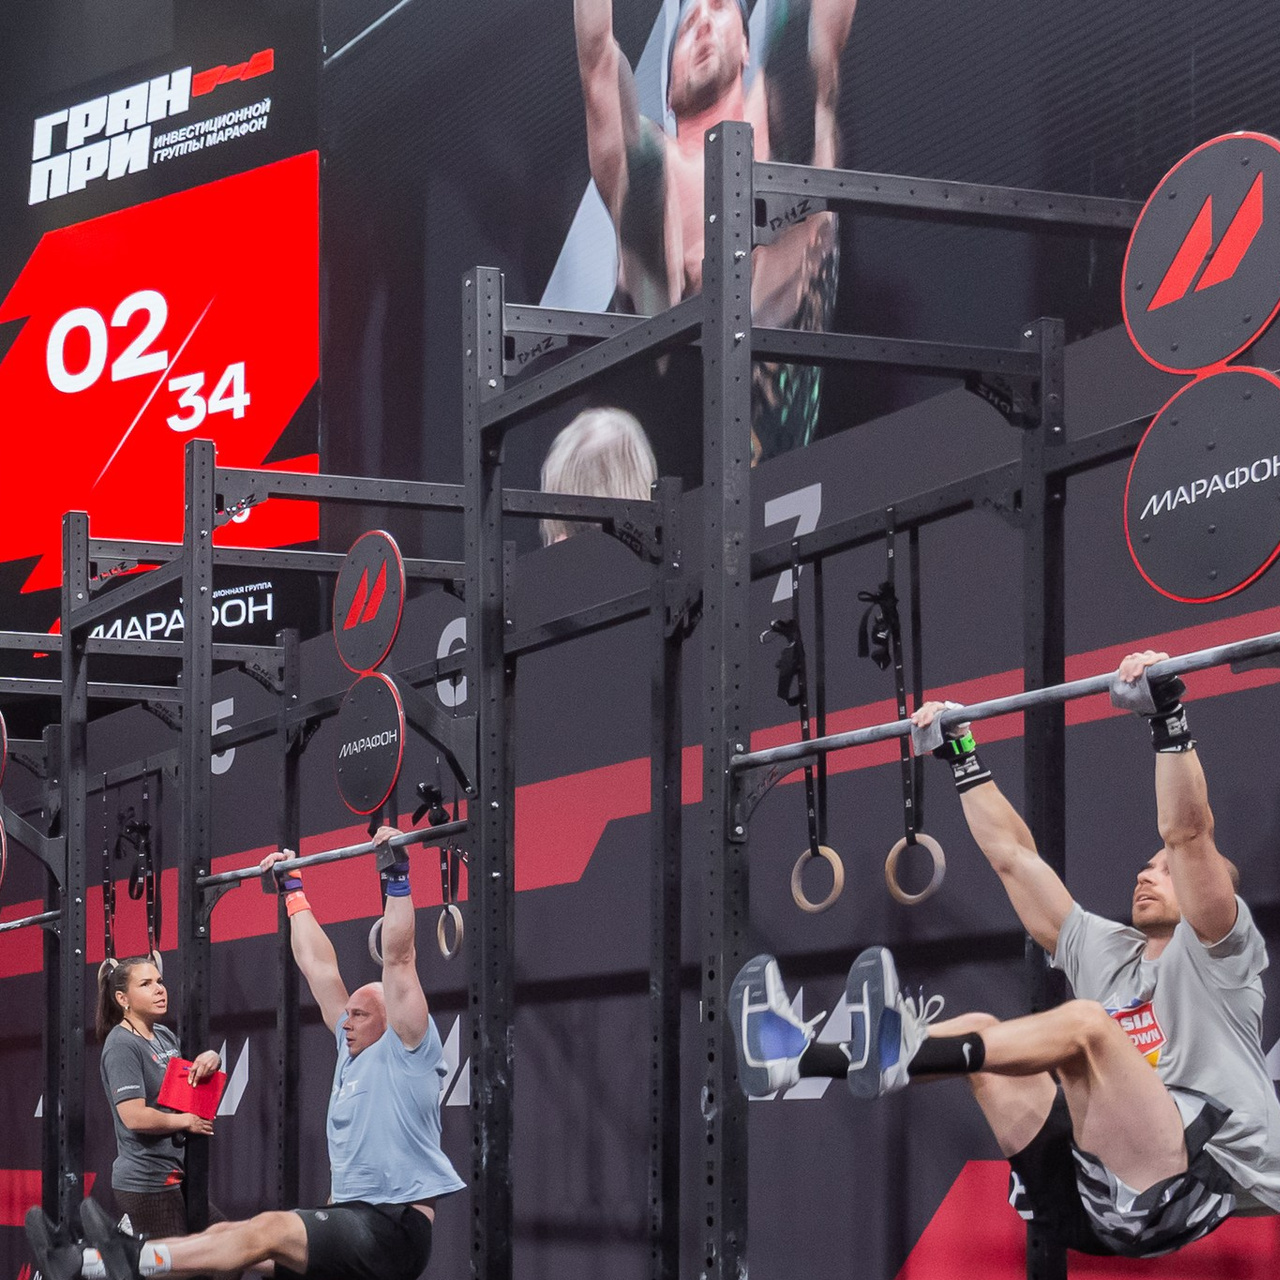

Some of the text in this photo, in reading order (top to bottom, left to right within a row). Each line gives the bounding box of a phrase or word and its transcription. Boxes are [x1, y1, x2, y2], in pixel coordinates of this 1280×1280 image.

[32, 66, 192, 161] ГРАН
[153, 97, 272, 150] ИНВЕСТИЦИОННОЙ
[153, 116, 268, 164] ГРУППЫ МАРАФОН
[28, 125, 151, 206] ПРИ
[46, 289, 251, 432] 02 34
[765, 483, 821, 603] 7
[245, 581, 272, 593] ГРУППА
[338, 728, 398, 759] МАРАФОН
[1120, 1011, 1154, 1032] SIA
[1129, 1028, 1161, 1047] OWN
